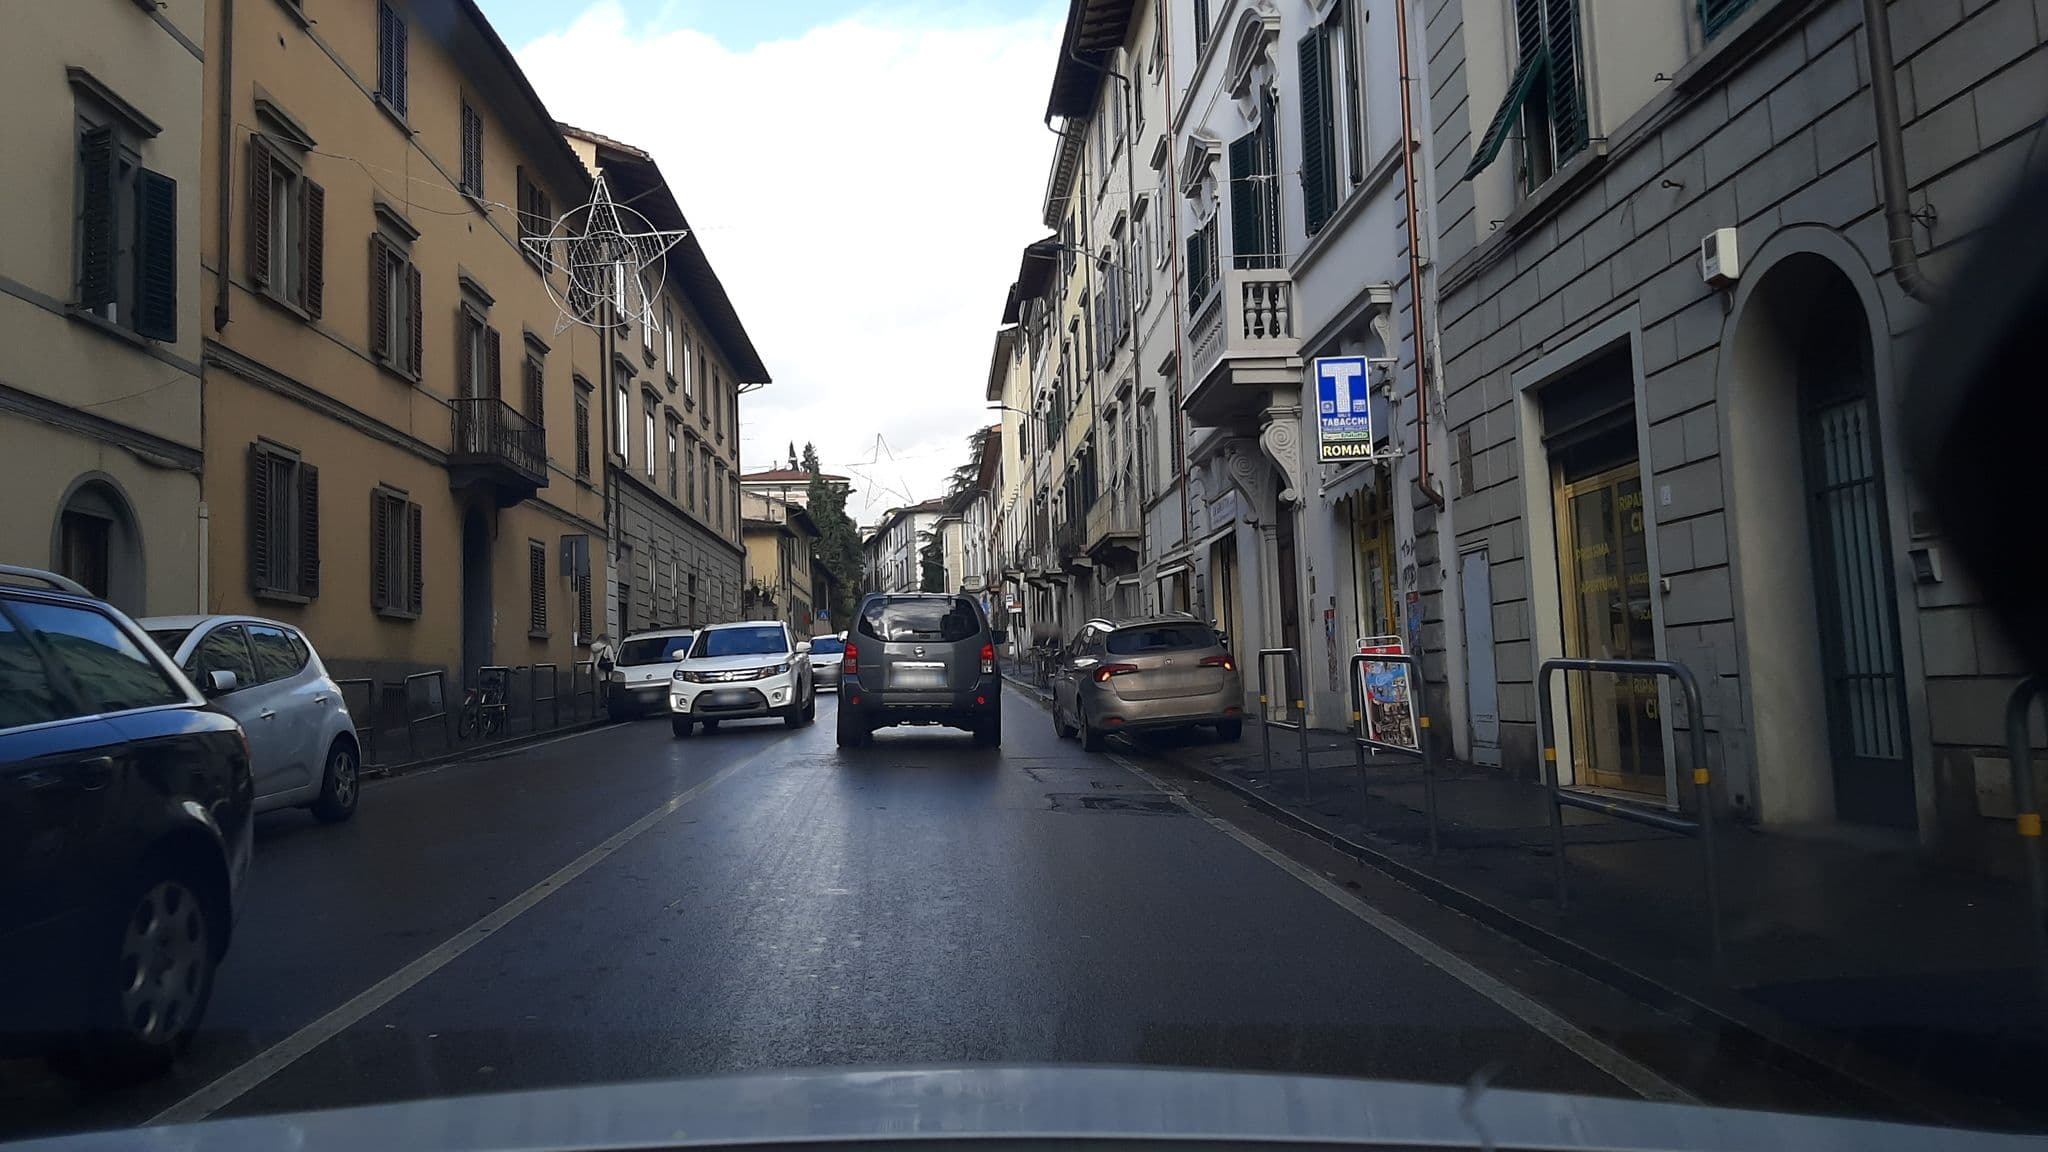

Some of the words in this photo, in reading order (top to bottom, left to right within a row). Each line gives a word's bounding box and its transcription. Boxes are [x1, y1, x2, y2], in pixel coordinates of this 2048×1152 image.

[1321, 363, 1361, 413] T
[1322, 417, 1367, 427] TABACCHI
[1323, 445, 1370, 456] ROMAN
